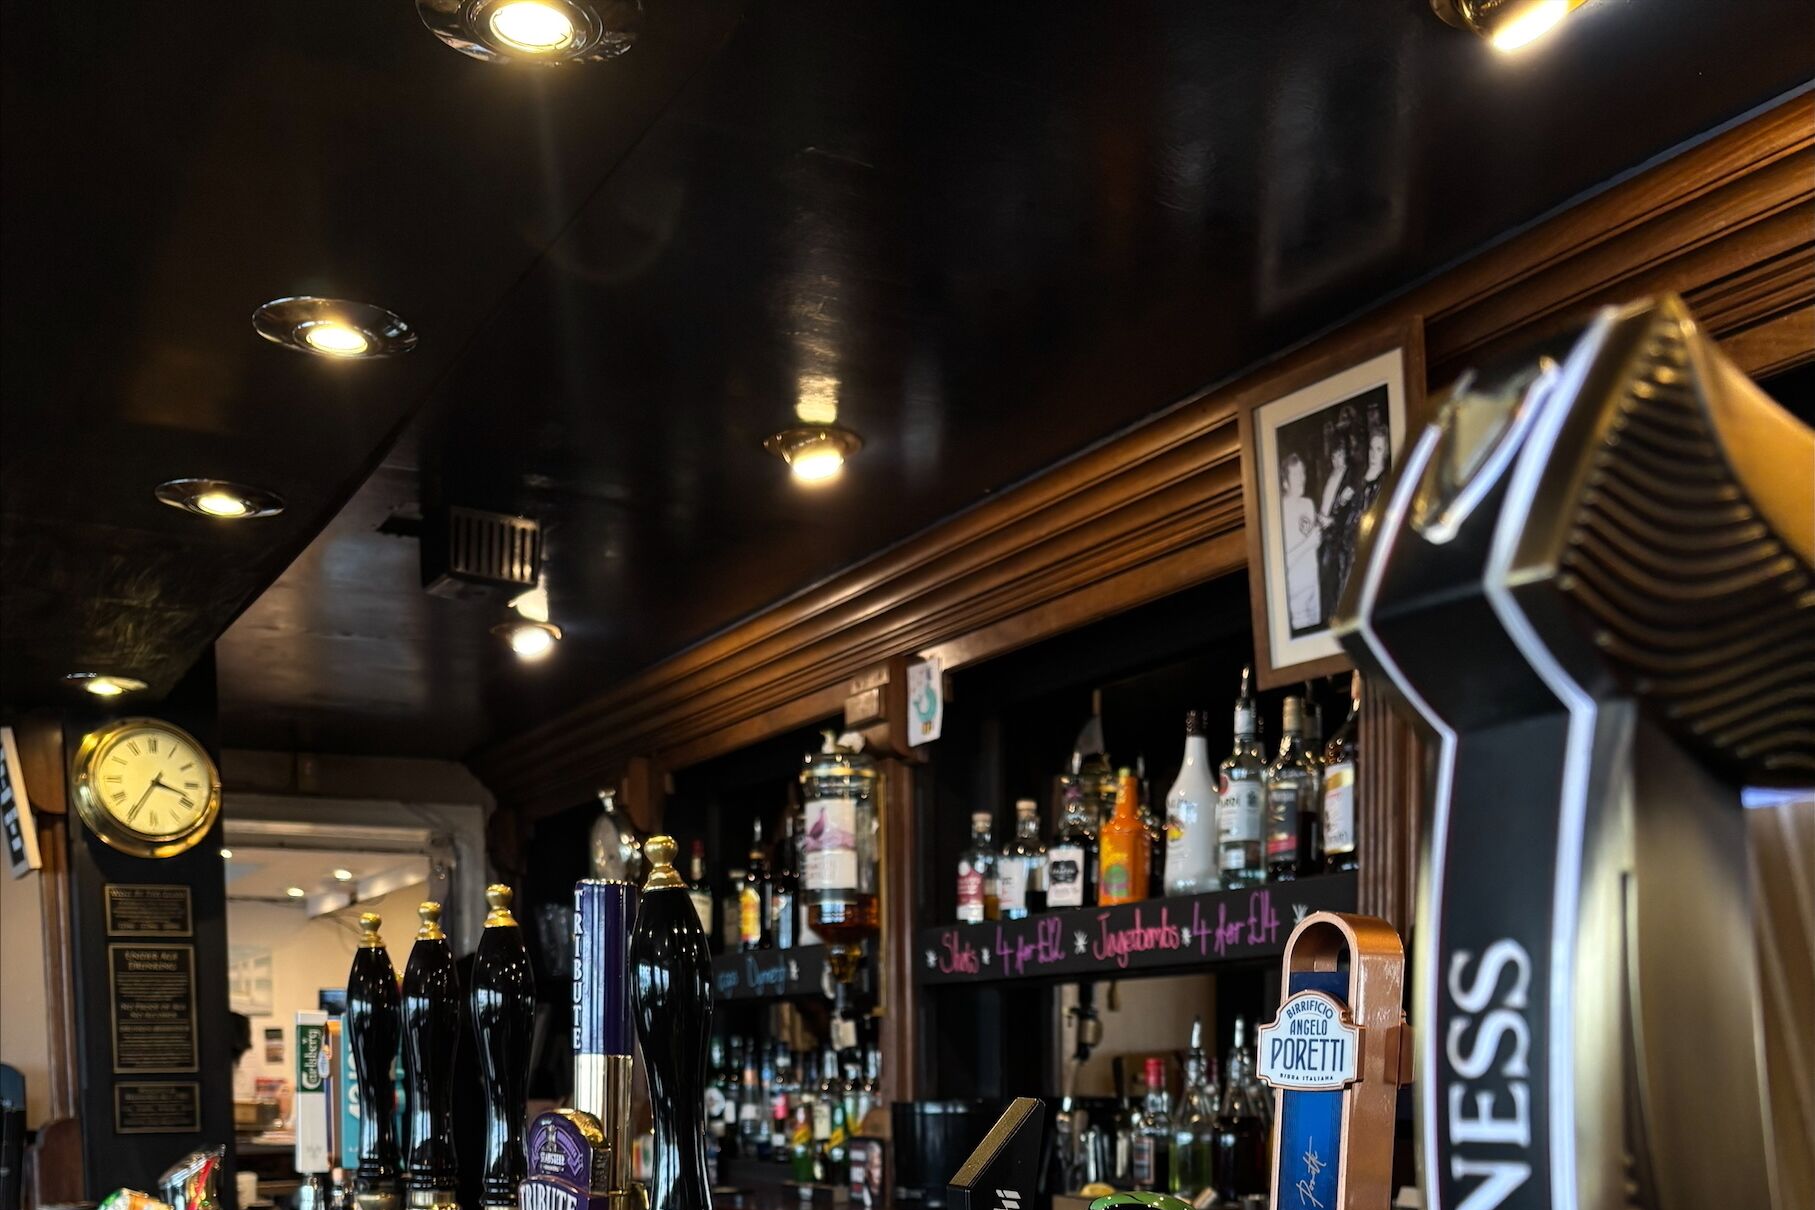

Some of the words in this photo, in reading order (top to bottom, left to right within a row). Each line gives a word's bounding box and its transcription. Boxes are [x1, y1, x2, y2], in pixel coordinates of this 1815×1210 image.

[1191, 900, 1211, 956] 4
[1214, 902, 1246, 957] for
[1246, 889, 1280, 946] £14
[572, 890, 584, 1050] TRIBUTE
[995, 925, 1014, 976] 4
[1286, 1000, 1334, 1019] BIRRIFICIO
[1290, 1019, 1328, 1036] ANGELO
[302, 1028, 322, 1090] Carlsberg
[1270, 1037, 1345, 1072] PORETTI
